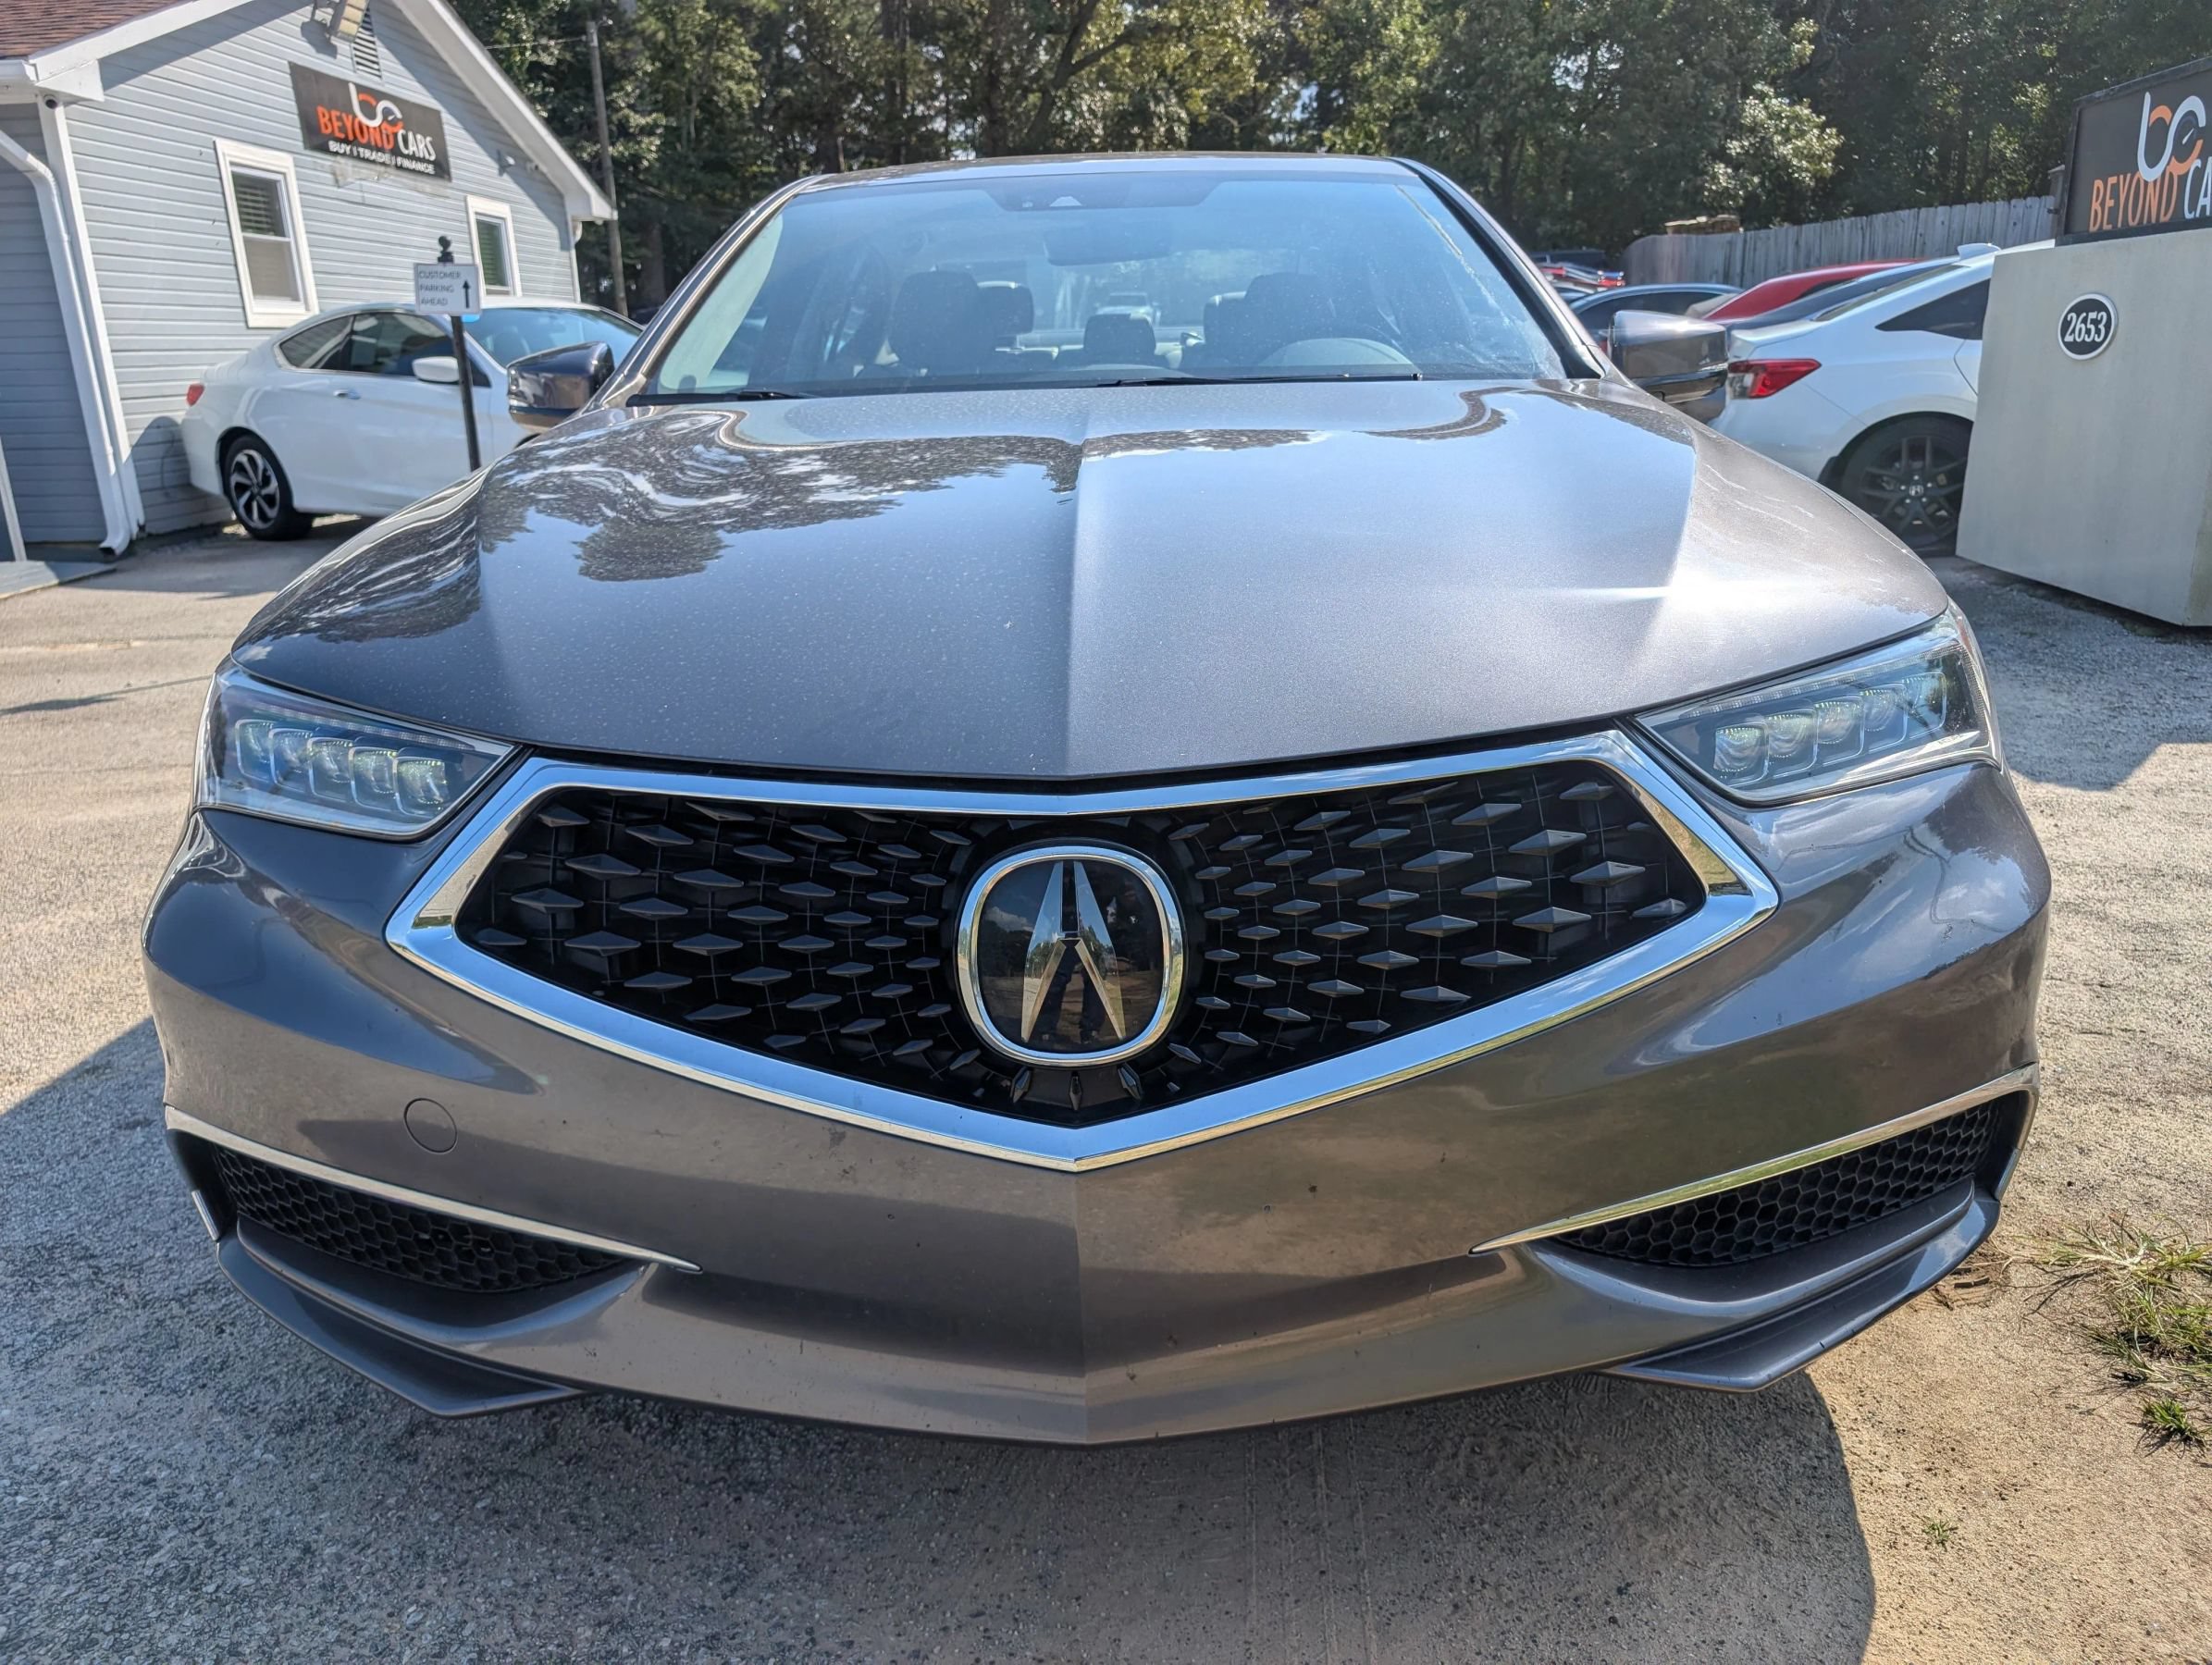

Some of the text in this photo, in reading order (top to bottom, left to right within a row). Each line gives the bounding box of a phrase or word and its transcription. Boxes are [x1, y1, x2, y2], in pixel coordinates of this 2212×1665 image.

[316, 105, 437, 161] BEYOND CARS
[328, 140, 351, 155] BUY
[358, 147, 391, 165] TRADE
[396, 156, 436, 175] FINANCE
[2089, 165, 2178, 232] BEYOND
[419, 270, 462, 279] CUSTOMER
[420, 284, 455, 293] PARKING
[421, 297, 449, 306] AHEAD
[2064, 311, 2107, 342] 2653
